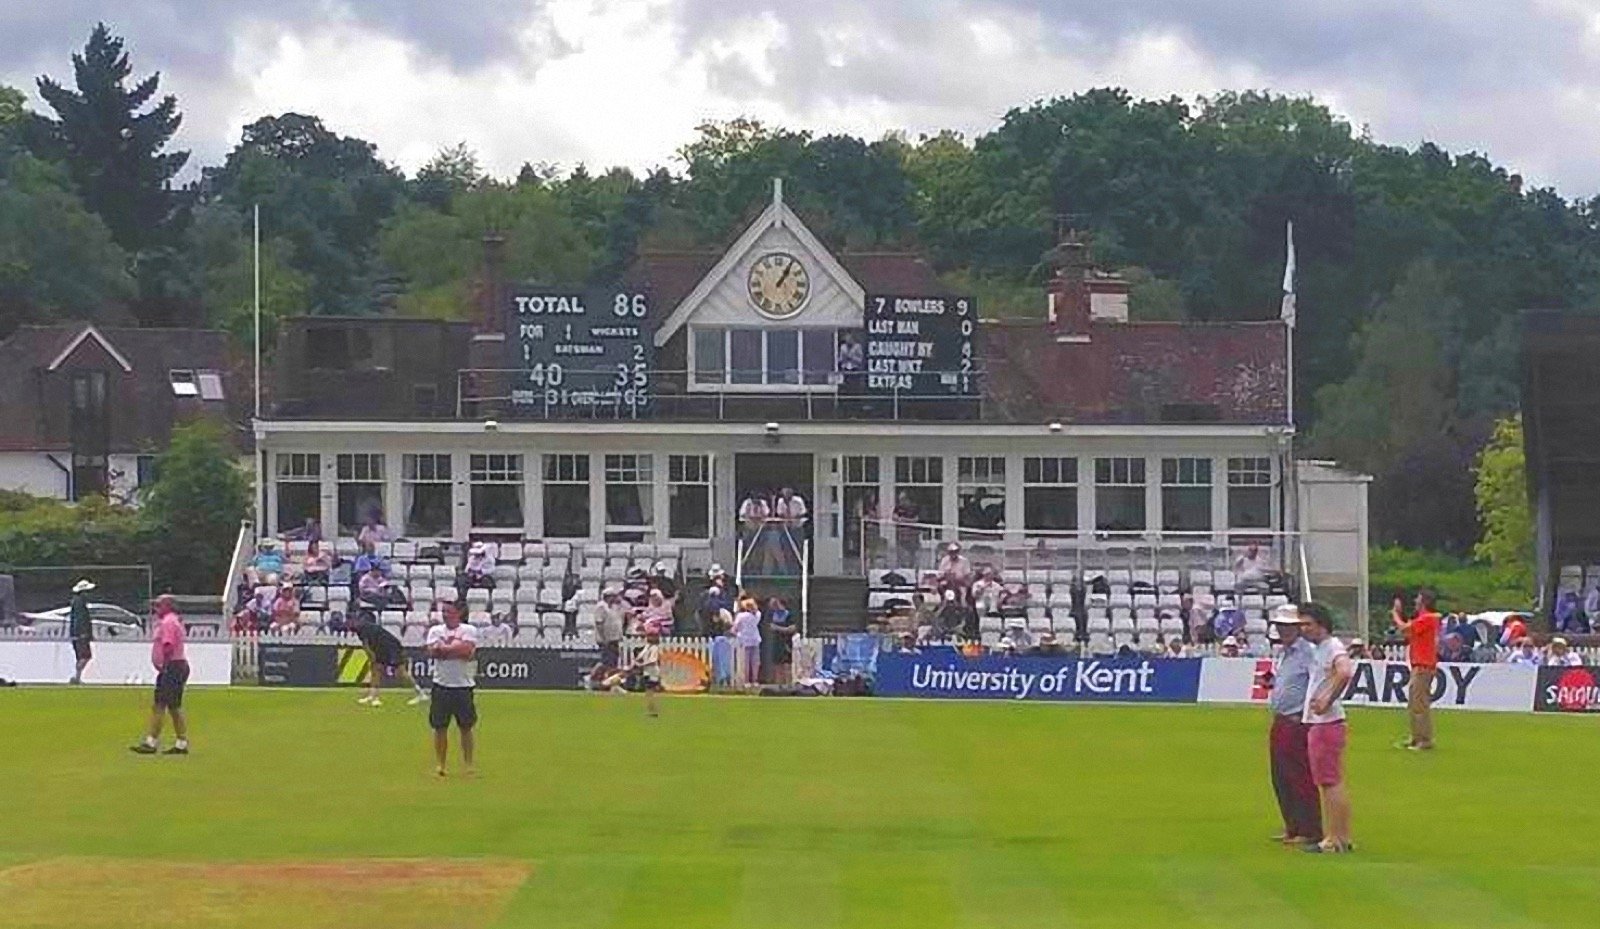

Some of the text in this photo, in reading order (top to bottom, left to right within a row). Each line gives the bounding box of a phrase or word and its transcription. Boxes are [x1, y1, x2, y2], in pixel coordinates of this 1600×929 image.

[515, 293, 647, 317] TOTAL 86
[875, 297, 886, 315] 7
[956, 299, 968, 316] 9
[520, 324, 544, 339] FOR
[868, 319, 894, 334] LAST
[961, 319, 972, 336] 0
[633, 344, 644, 361] 2
[917, 342, 934, 358] BY
[529, 362, 648, 387] 40 35
[868, 359, 896, 373] LAST
[961, 358, 972, 375] 2
[868, 374, 913, 389] EXTRAS
[912, 660, 1154, 699] University of Kent
[1342, 662, 1480, 704] ARDY
[1546, 685, 1600, 704] SAMU
